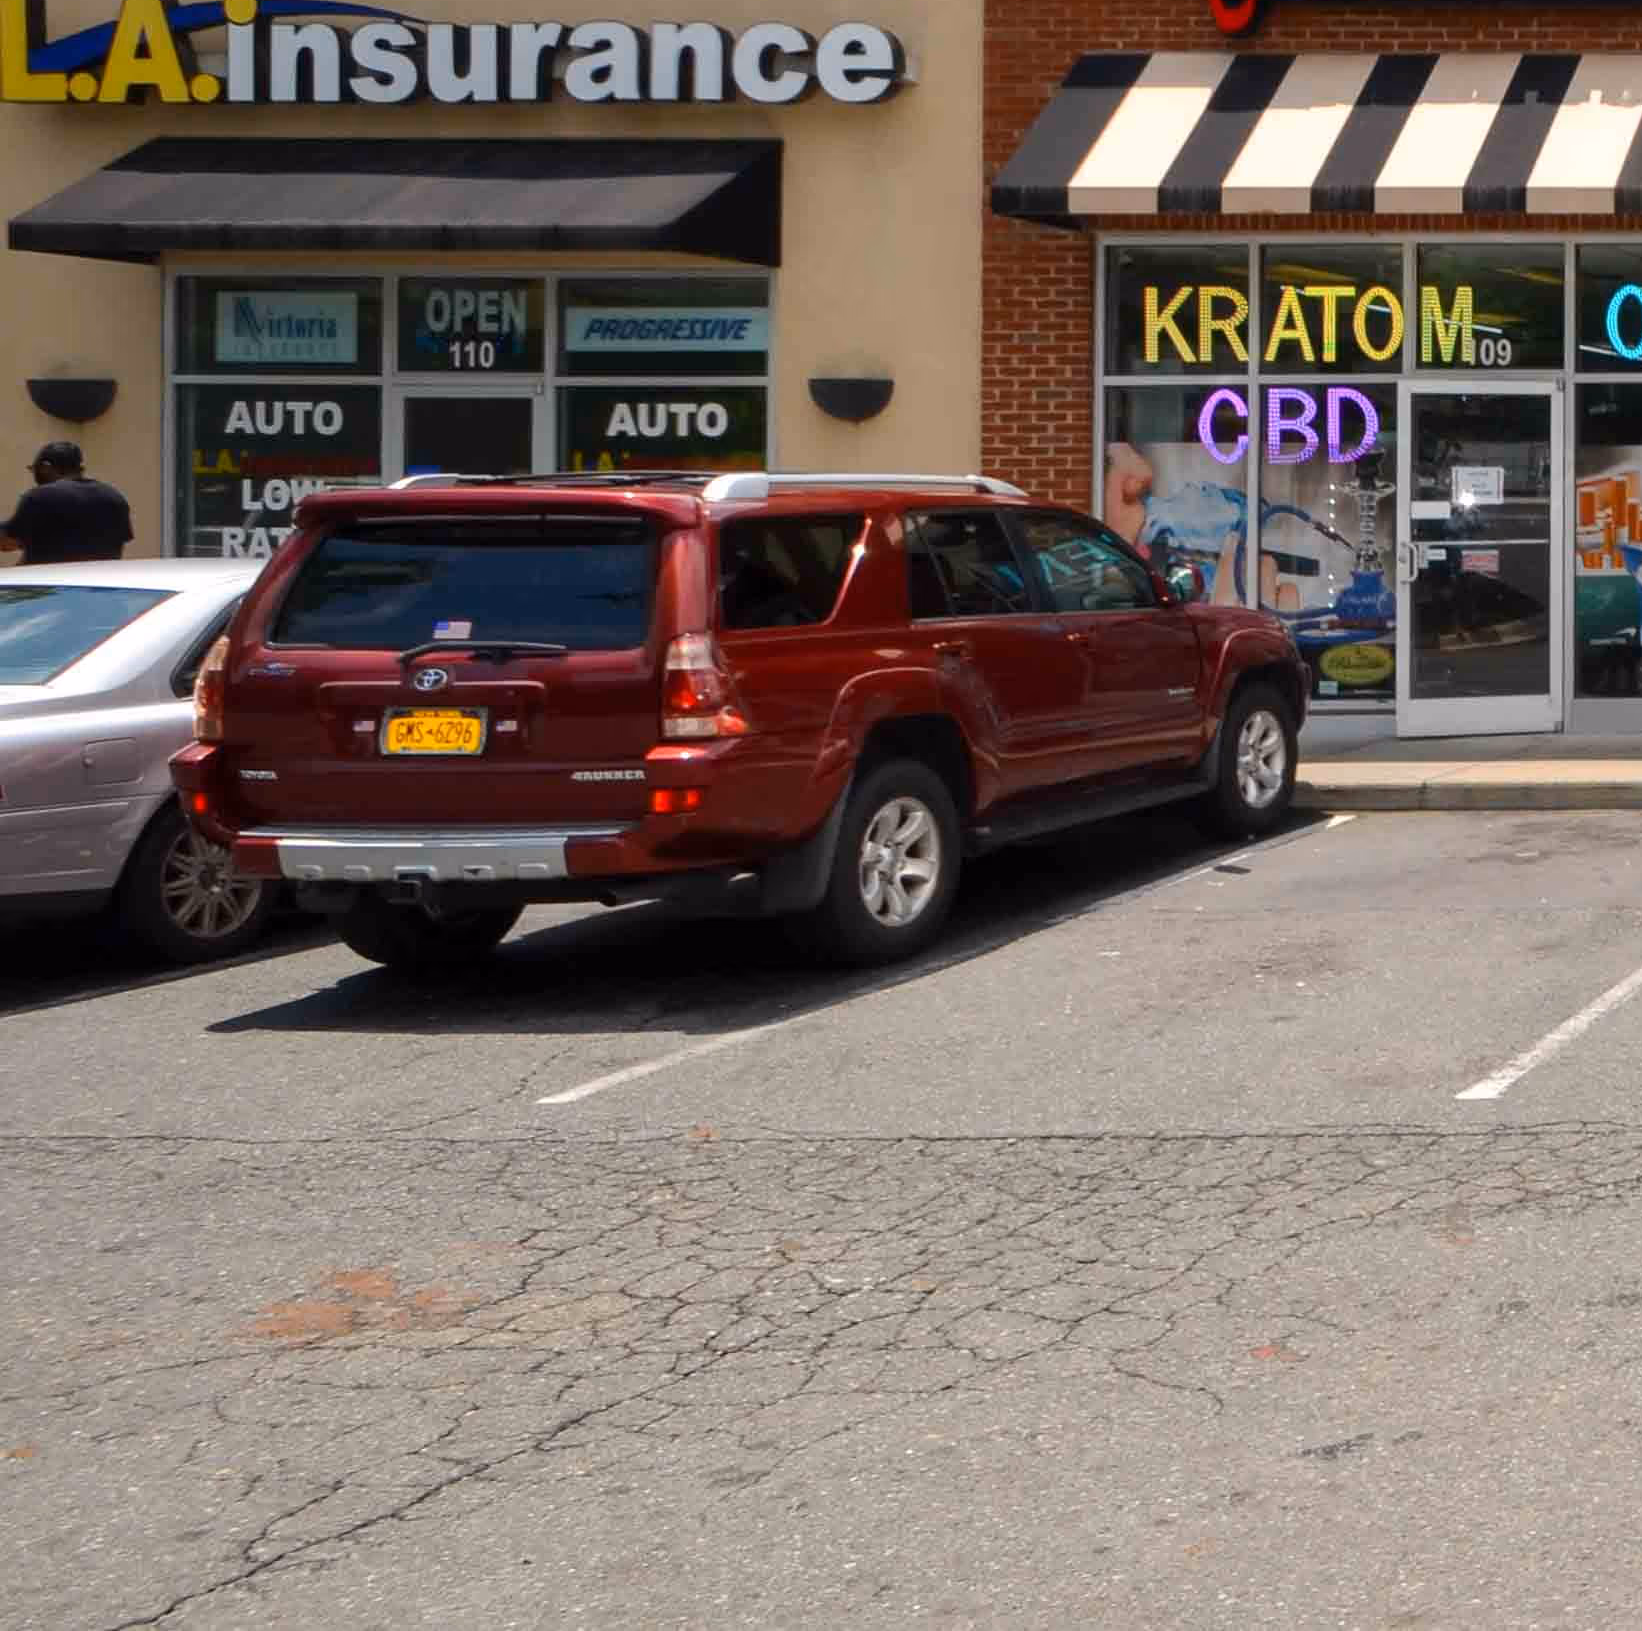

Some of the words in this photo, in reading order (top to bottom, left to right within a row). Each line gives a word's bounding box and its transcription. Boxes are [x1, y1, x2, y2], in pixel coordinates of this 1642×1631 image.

[425, 290, 528, 335] OPEN
[584, 318, 753, 341] PROGRESSIVE
[1143, 285, 1472, 363] KRATOM
[450, 341, 494, 368] 110
[224, 401, 344, 436] AUTO
[606, 403, 729, 437] AUTO
[1199, 388, 1380, 465] CBD
